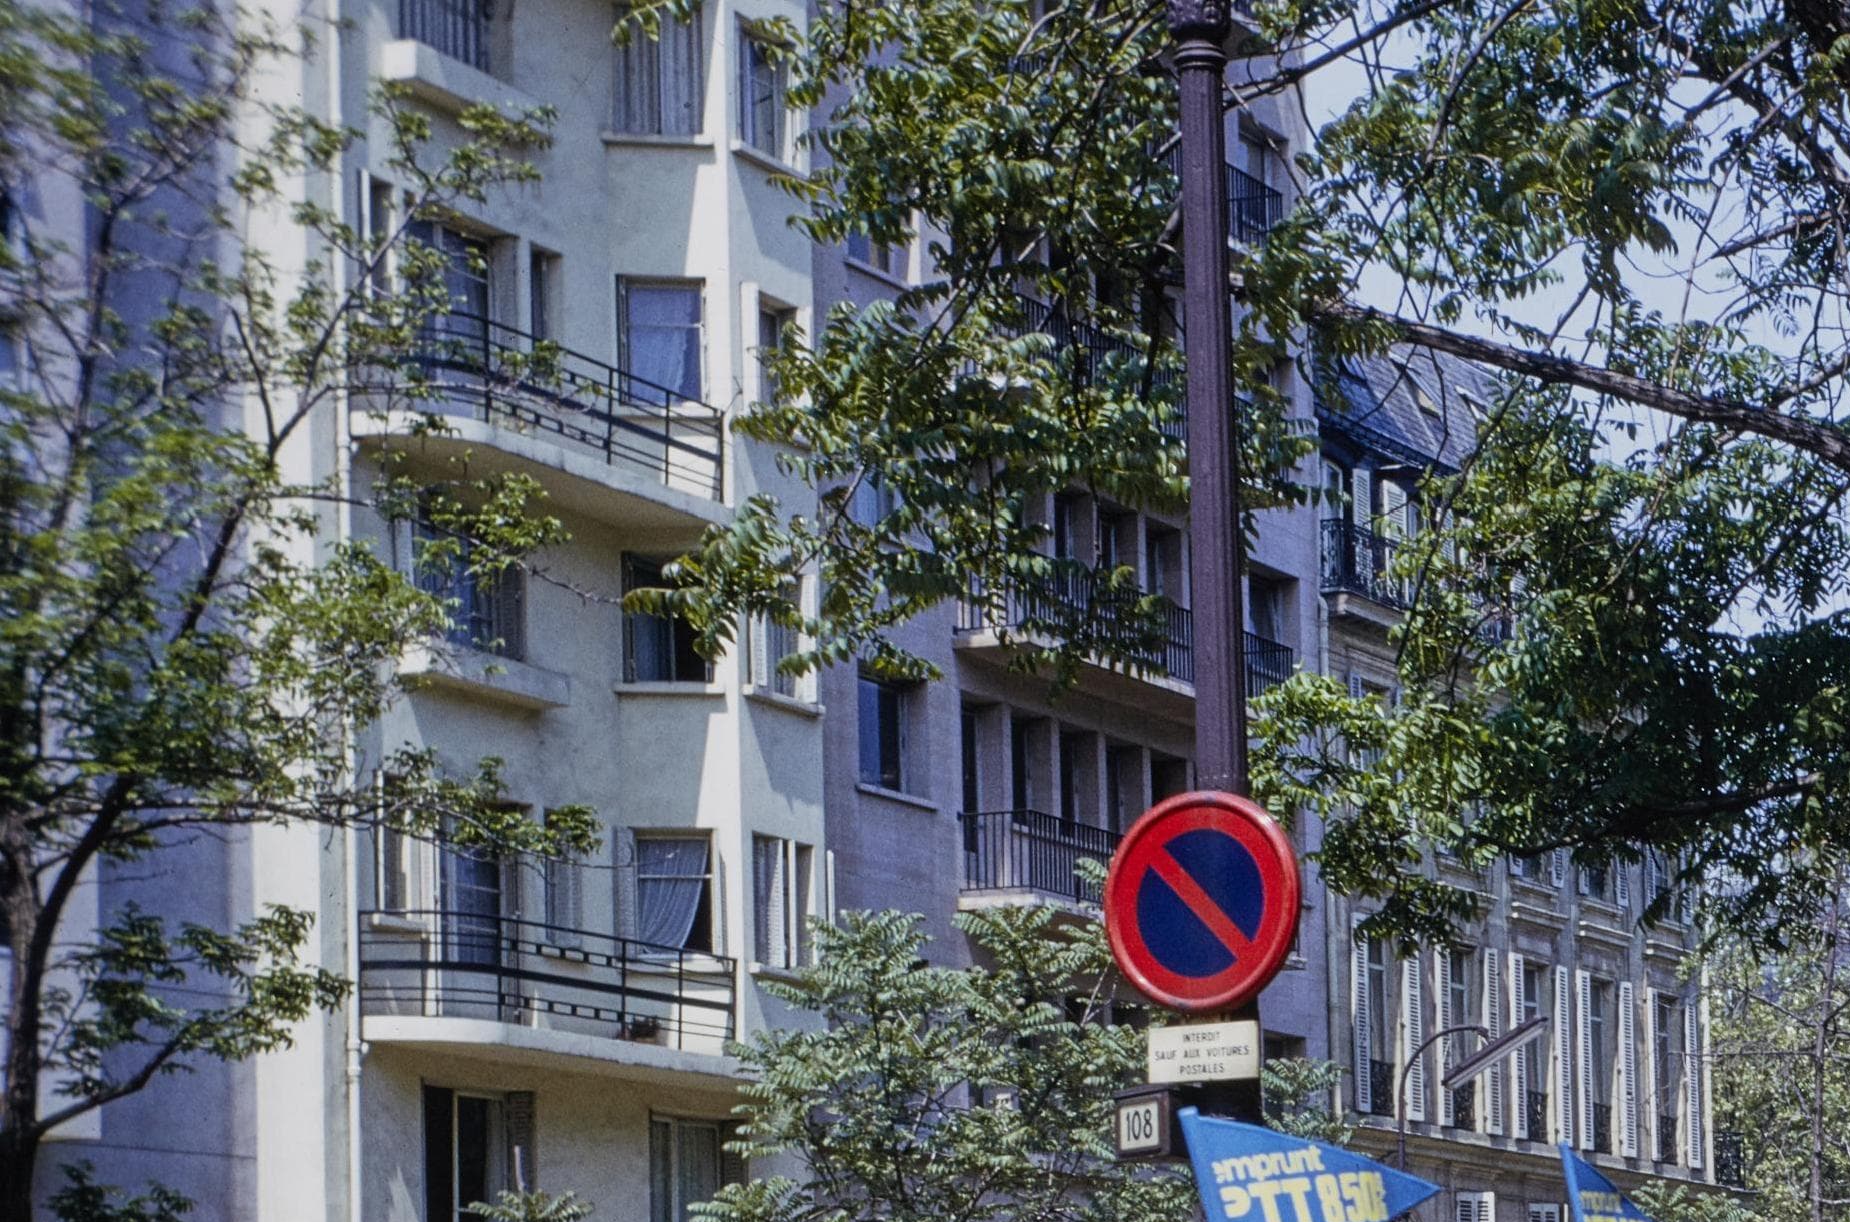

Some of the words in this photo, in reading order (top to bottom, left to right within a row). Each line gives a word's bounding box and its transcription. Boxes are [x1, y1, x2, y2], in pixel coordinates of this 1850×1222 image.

[1182, 1031, 1221, 1043] INTERDIT
[1154, 1050, 1178, 1062] SAUF
[1183, 1048, 1200, 1059] AUX
[1206, 1045, 1249, 1058] VOITURES
[1179, 1063, 1225, 1075] POSTALES
[1125, 1108, 1153, 1142] 108
